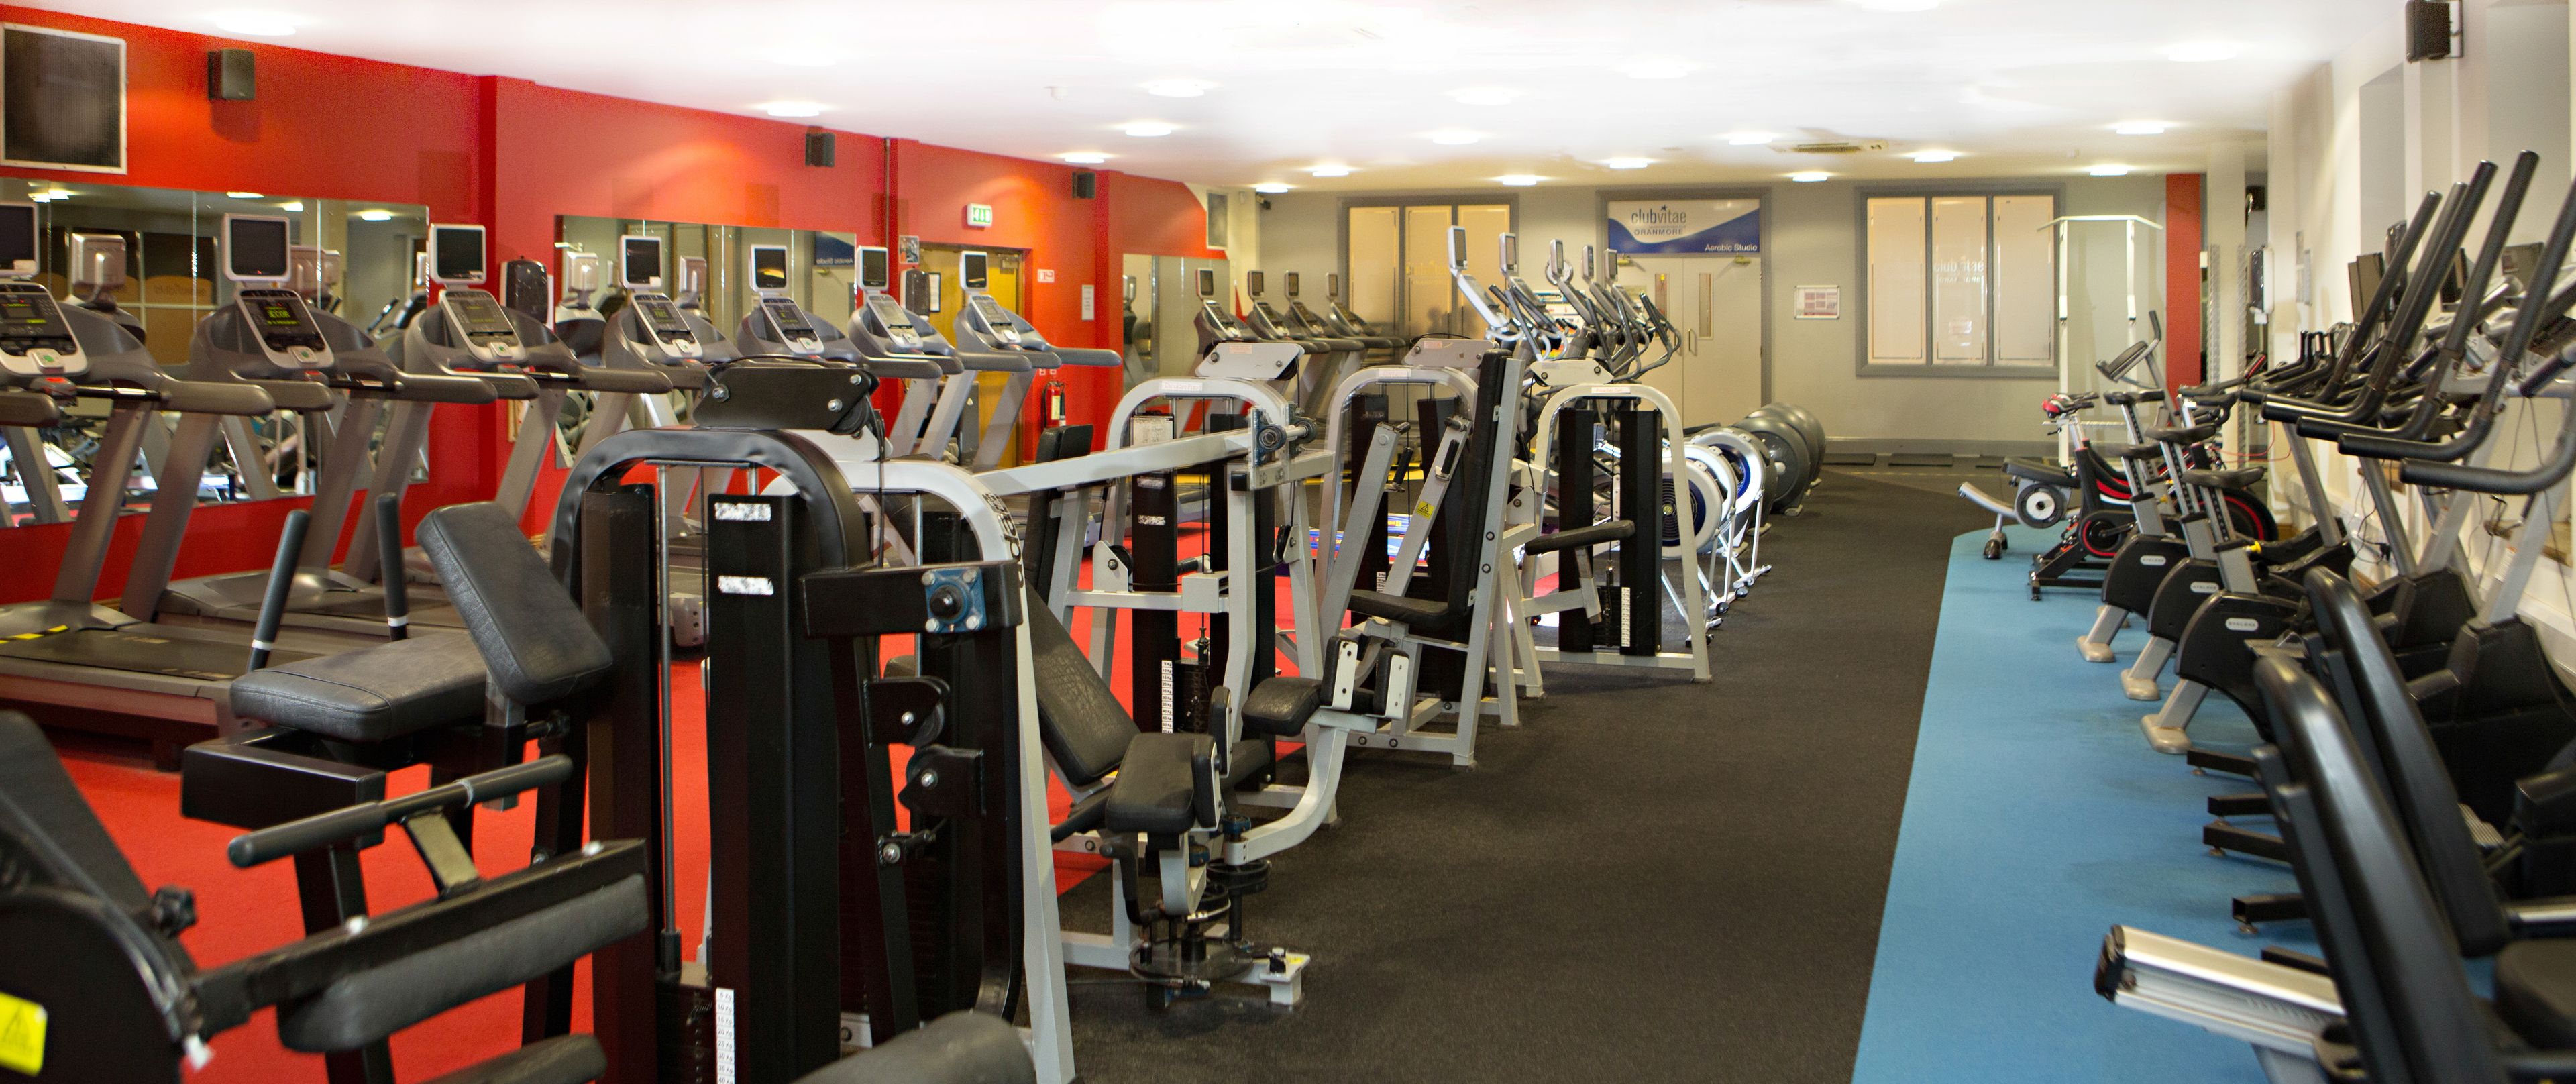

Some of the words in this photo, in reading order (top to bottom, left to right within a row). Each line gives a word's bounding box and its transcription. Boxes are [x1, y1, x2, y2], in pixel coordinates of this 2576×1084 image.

[1631, 209, 1686, 224] clubvitae
[1705, 243, 1732, 252] Aerobic
[1734, 243, 1758, 252] Studio
